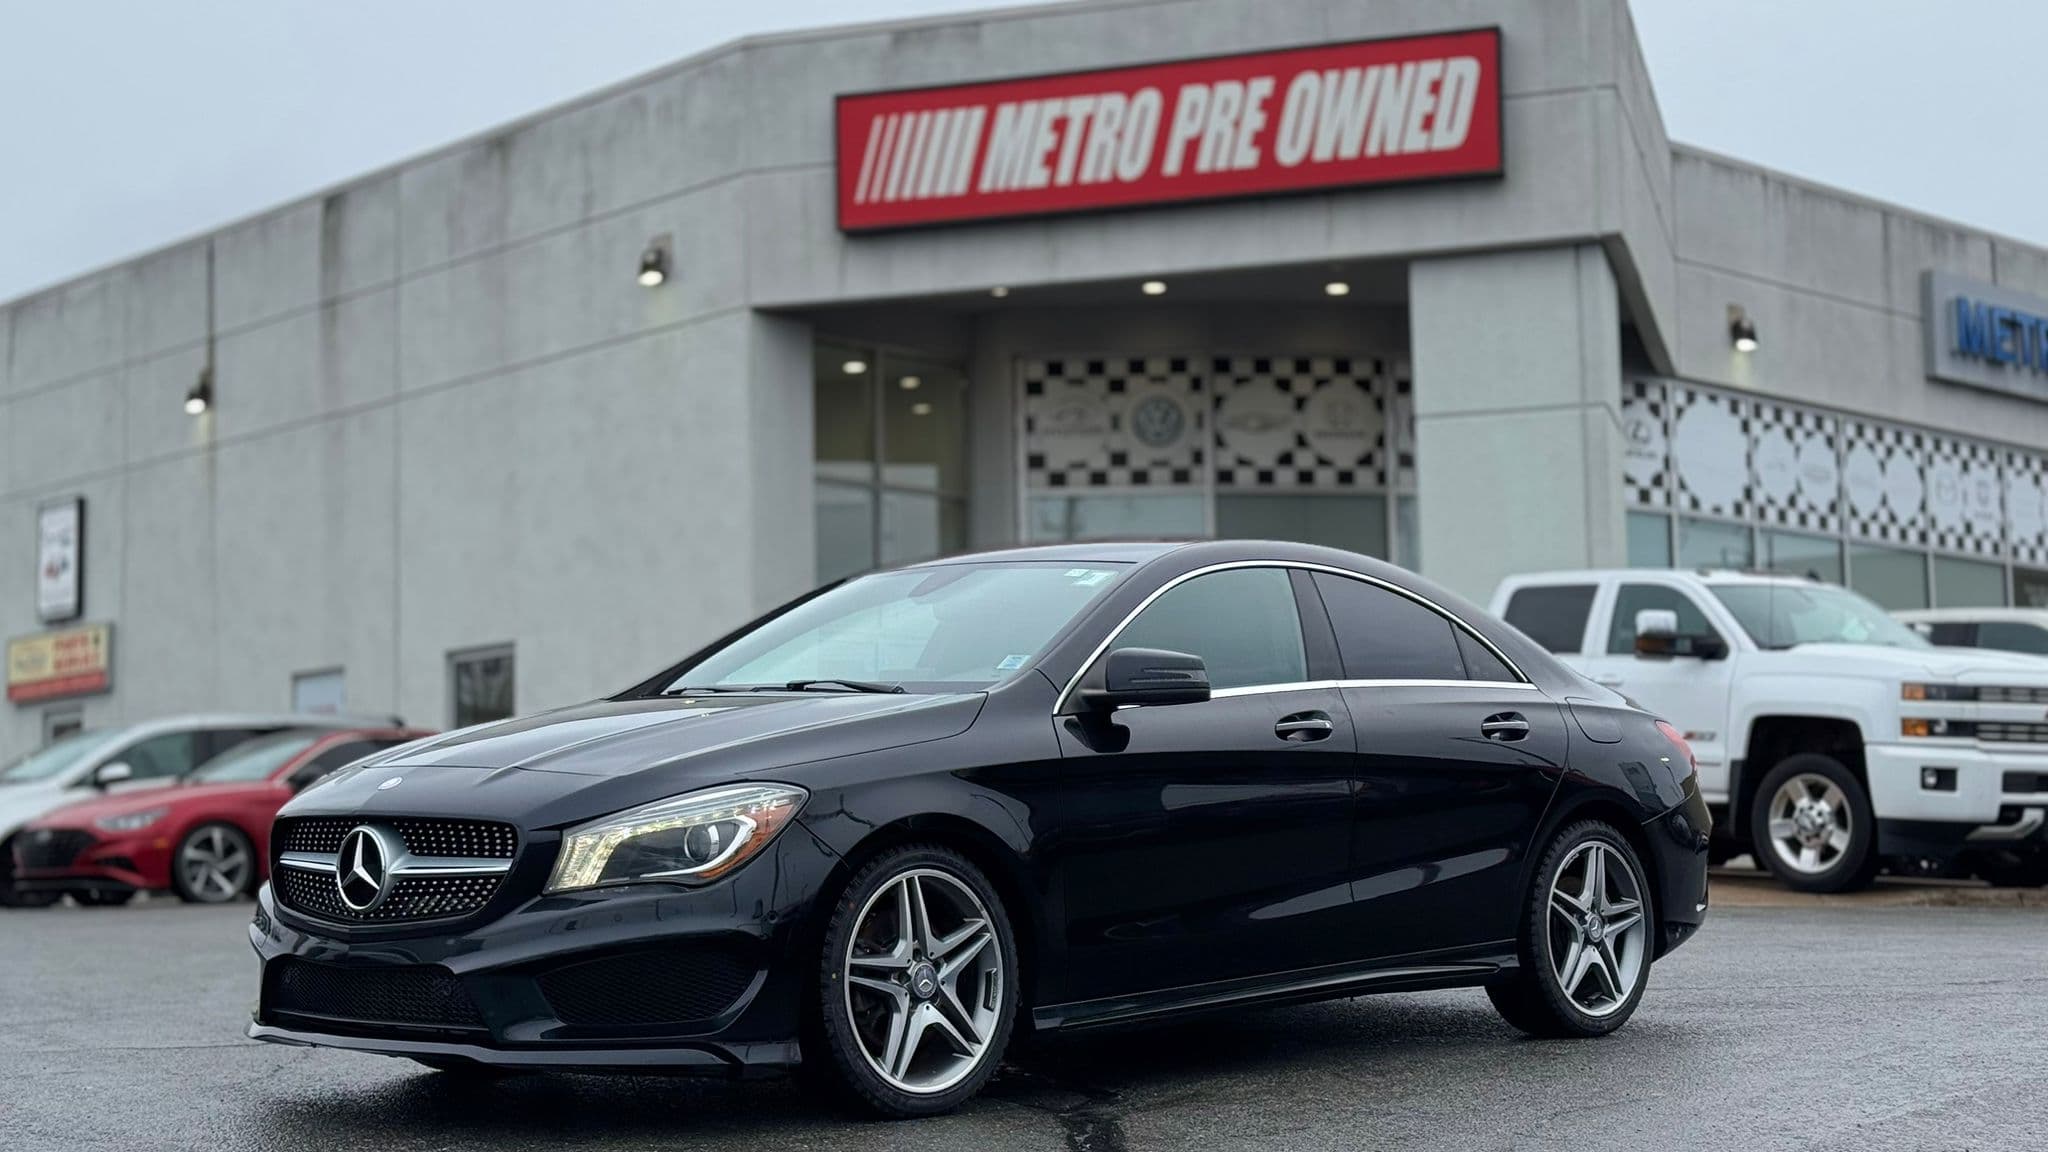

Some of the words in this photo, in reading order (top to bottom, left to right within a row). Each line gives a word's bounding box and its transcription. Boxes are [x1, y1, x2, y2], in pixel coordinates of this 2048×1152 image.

[978, 86, 1164, 192] METRO
[1161, 75, 1275, 176] PRE
[1274, 56, 1482, 168] OWNED
